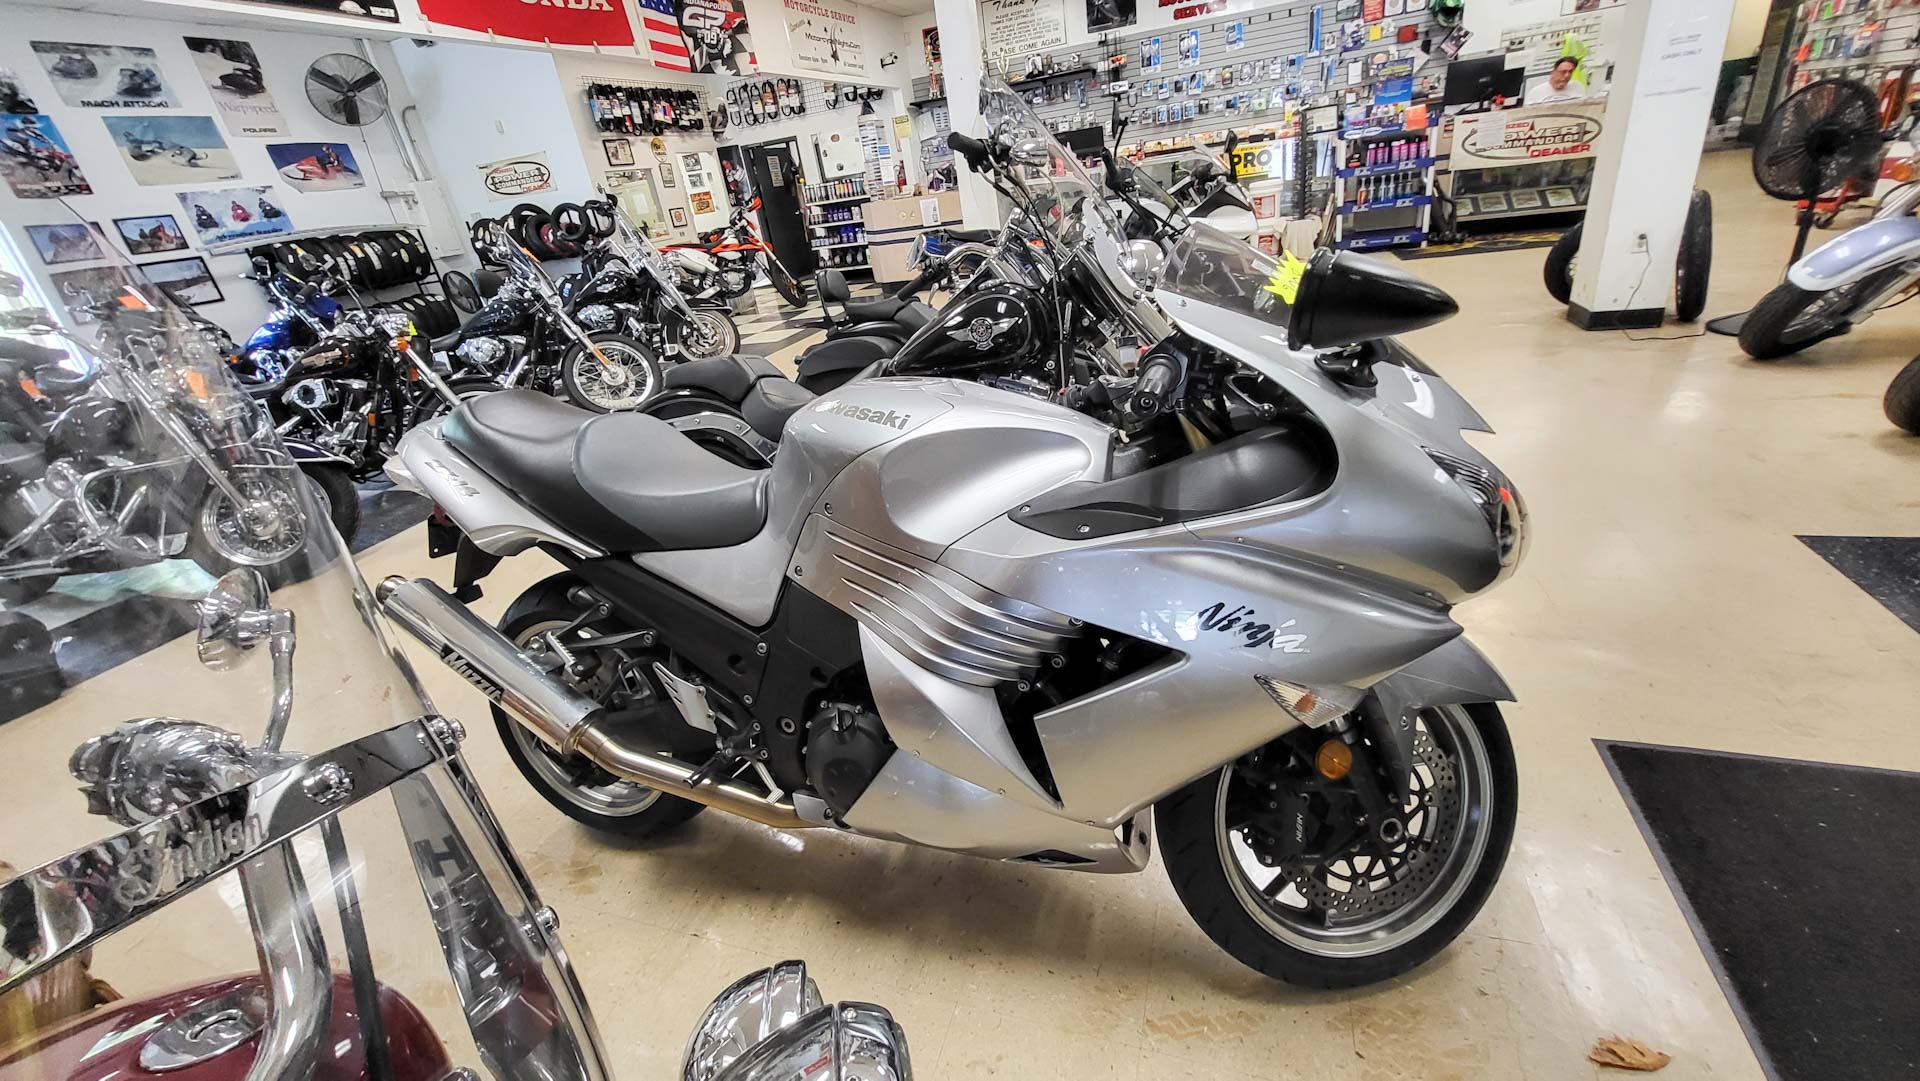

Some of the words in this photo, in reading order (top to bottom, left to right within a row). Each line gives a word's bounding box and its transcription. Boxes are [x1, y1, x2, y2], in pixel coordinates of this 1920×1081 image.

[682, 6, 726, 30] GP
[784, 0, 830, 18] MOTORCYCLE
[830, 10, 856, 25] SERVICE
[992, 48, 1016, 57] PLASE
[1019, 41, 1038, 51] COME
[1041, 37, 1061, 47] AGAIN
[80, 99, 121, 109] MACH
[122, 99, 170, 109] ATTACK!
[1503, 123, 1579, 141] OWER
[1231, 149, 1273, 169] PRO
[1529, 143, 1591, 159] DEALER
[494, 168, 541, 183] POWER
[522, 182, 552, 193] DEALER
[816, 399, 912, 431] wasaki
[1197, 601, 1311, 653] Ninja
[114, 812, 270, 912] Indian
